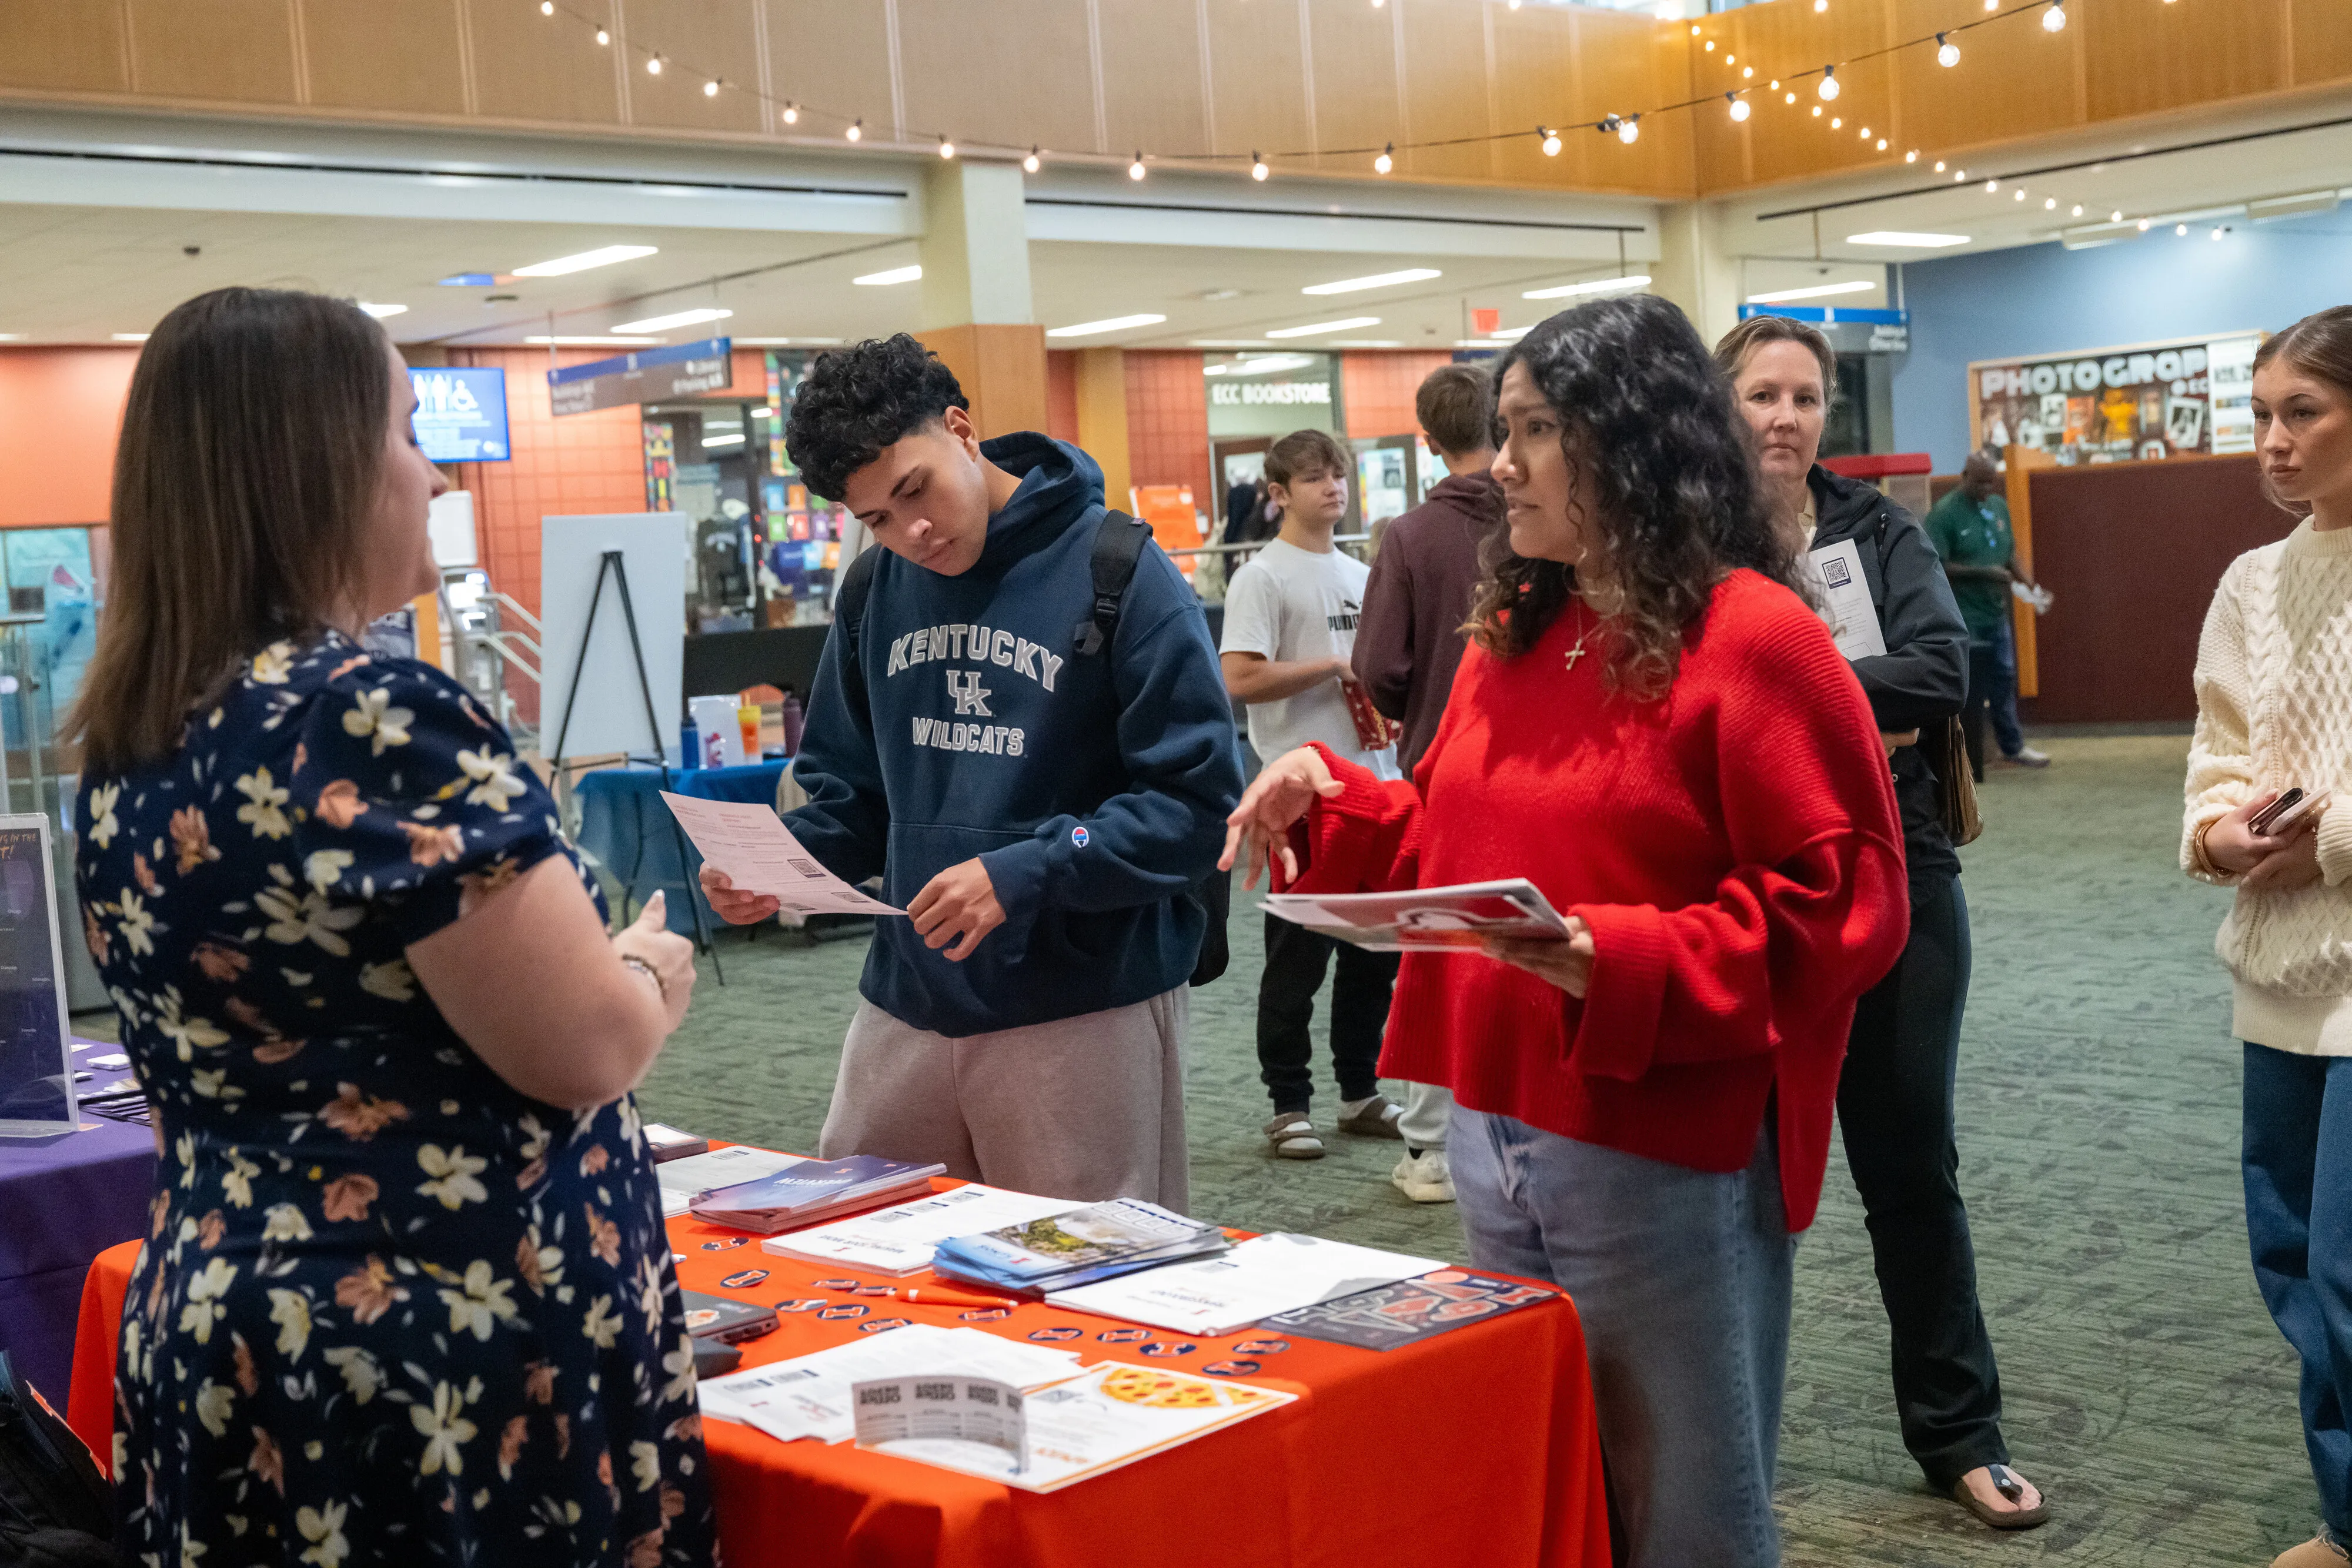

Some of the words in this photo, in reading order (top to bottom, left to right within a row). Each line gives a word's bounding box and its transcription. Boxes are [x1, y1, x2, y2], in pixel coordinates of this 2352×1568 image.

[1212, 383, 1240, 404] ECC
[1241, 383, 1331, 404] BOOKSTORE
[887, 624, 1064, 693] KENTUCKY
[946, 670, 993, 717] UK
[913, 717, 1025, 757] WILDCATS
[22, 833, 36, 842] THE
